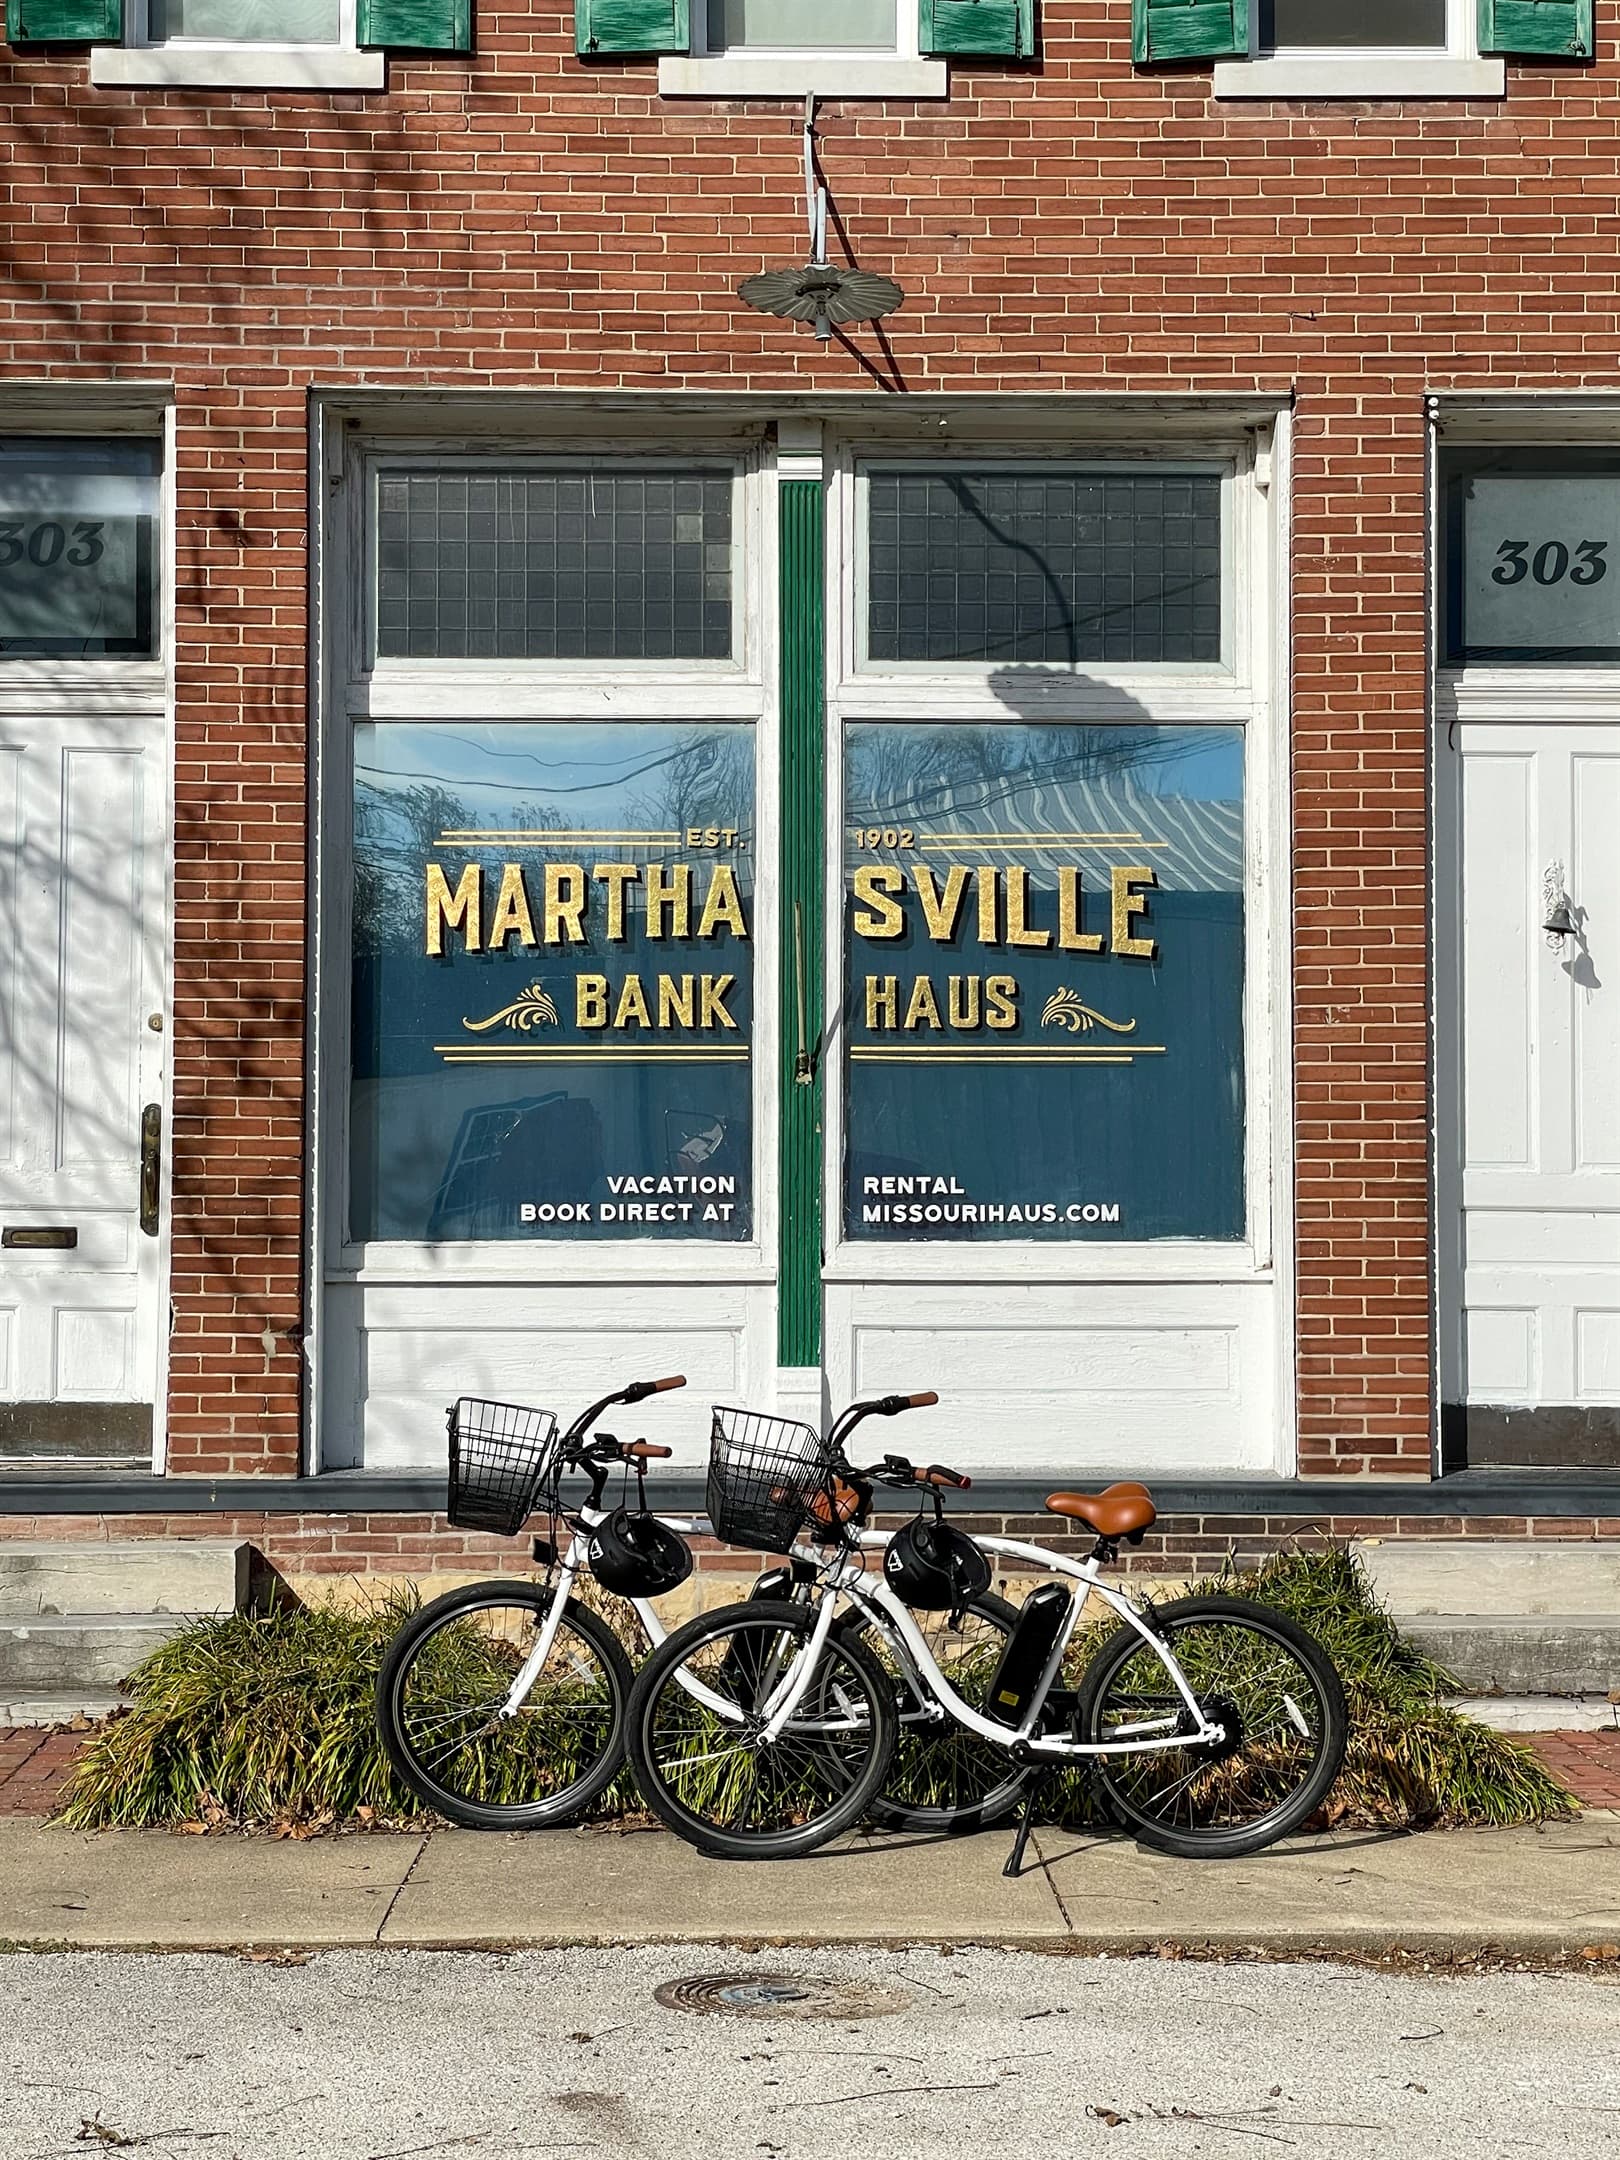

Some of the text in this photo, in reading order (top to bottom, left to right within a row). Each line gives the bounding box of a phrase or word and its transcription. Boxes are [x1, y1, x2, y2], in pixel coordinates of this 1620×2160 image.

[0, 521, 104, 567] 303
[1491, 539, 1608, 586] 303
[686, 828, 915, 849] EST. 1902
[426, 863, 1158, 957] MARTHA SVILLE
[575, 974, 1018, 1031] BANK HAUS
[607, 1176, 965, 1195] VACATION RENTAL
[520, 1203, 1120, 1223] BOOK DIRECT AT MISSOURIHAUS.COM
